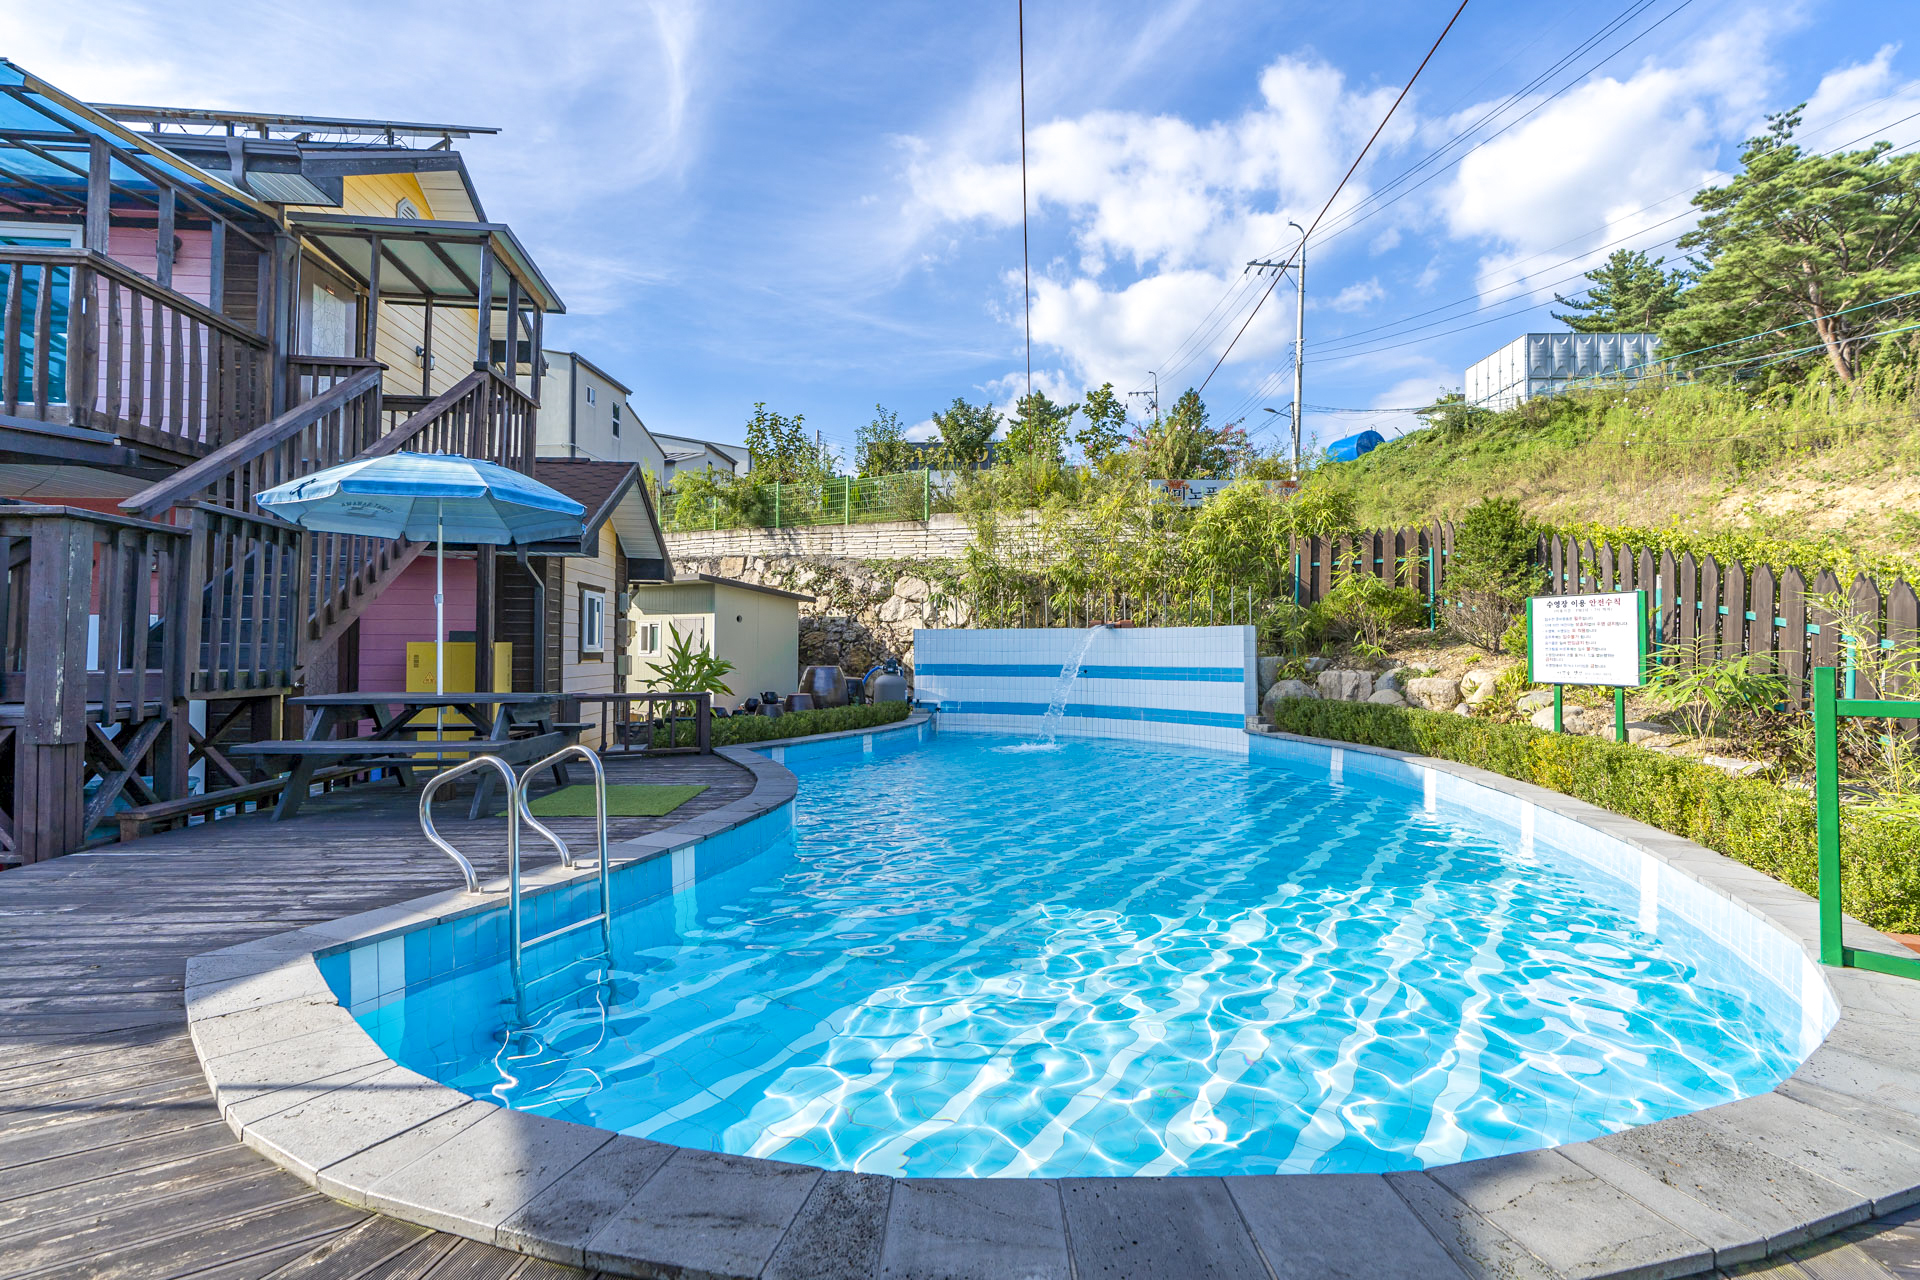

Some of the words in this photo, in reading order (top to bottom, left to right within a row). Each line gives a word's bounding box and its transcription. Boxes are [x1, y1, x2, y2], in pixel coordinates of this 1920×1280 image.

[1546, 599, 1568, 609] 수영장
[1571, 599, 1586, 608] 이용
[1588, 597, 1621, 607] 안전수칙
